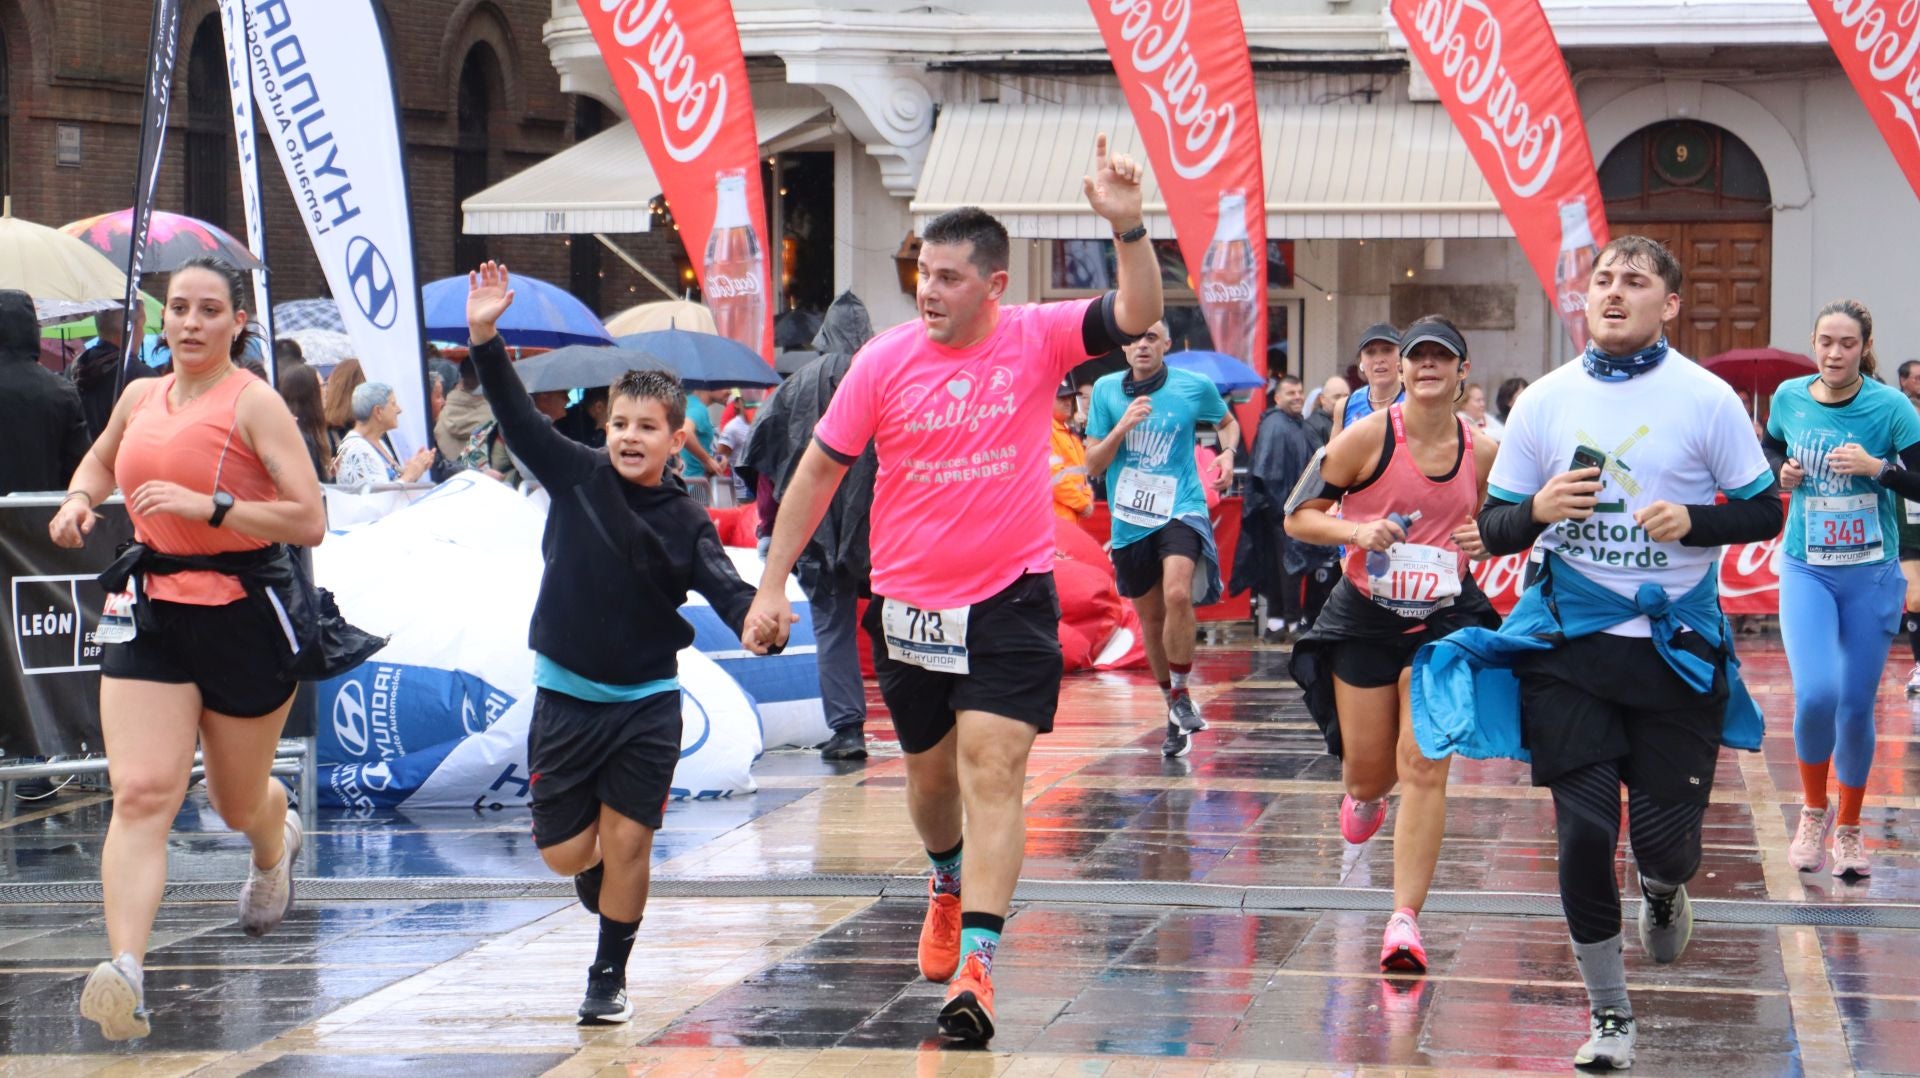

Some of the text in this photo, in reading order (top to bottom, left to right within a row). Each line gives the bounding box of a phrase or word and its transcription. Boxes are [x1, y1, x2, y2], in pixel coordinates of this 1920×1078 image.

[1676, 145, 1688, 163] 9
[971, 444, 1017, 465] GANAS
[1132, 489, 1155, 512] 811
[1823, 518, 1866, 546] 349
[1590, 546, 1669, 568] Verde
[1835, 551, 1871, 560] HYUNDAI
[1391, 570, 1439, 601] 1172
[21, 605, 73, 637] LEÓN
[906, 606, 945, 643] 713
[914, 654, 957, 665] HYUNDAI
[388, 668, 403, 733] Automoción
